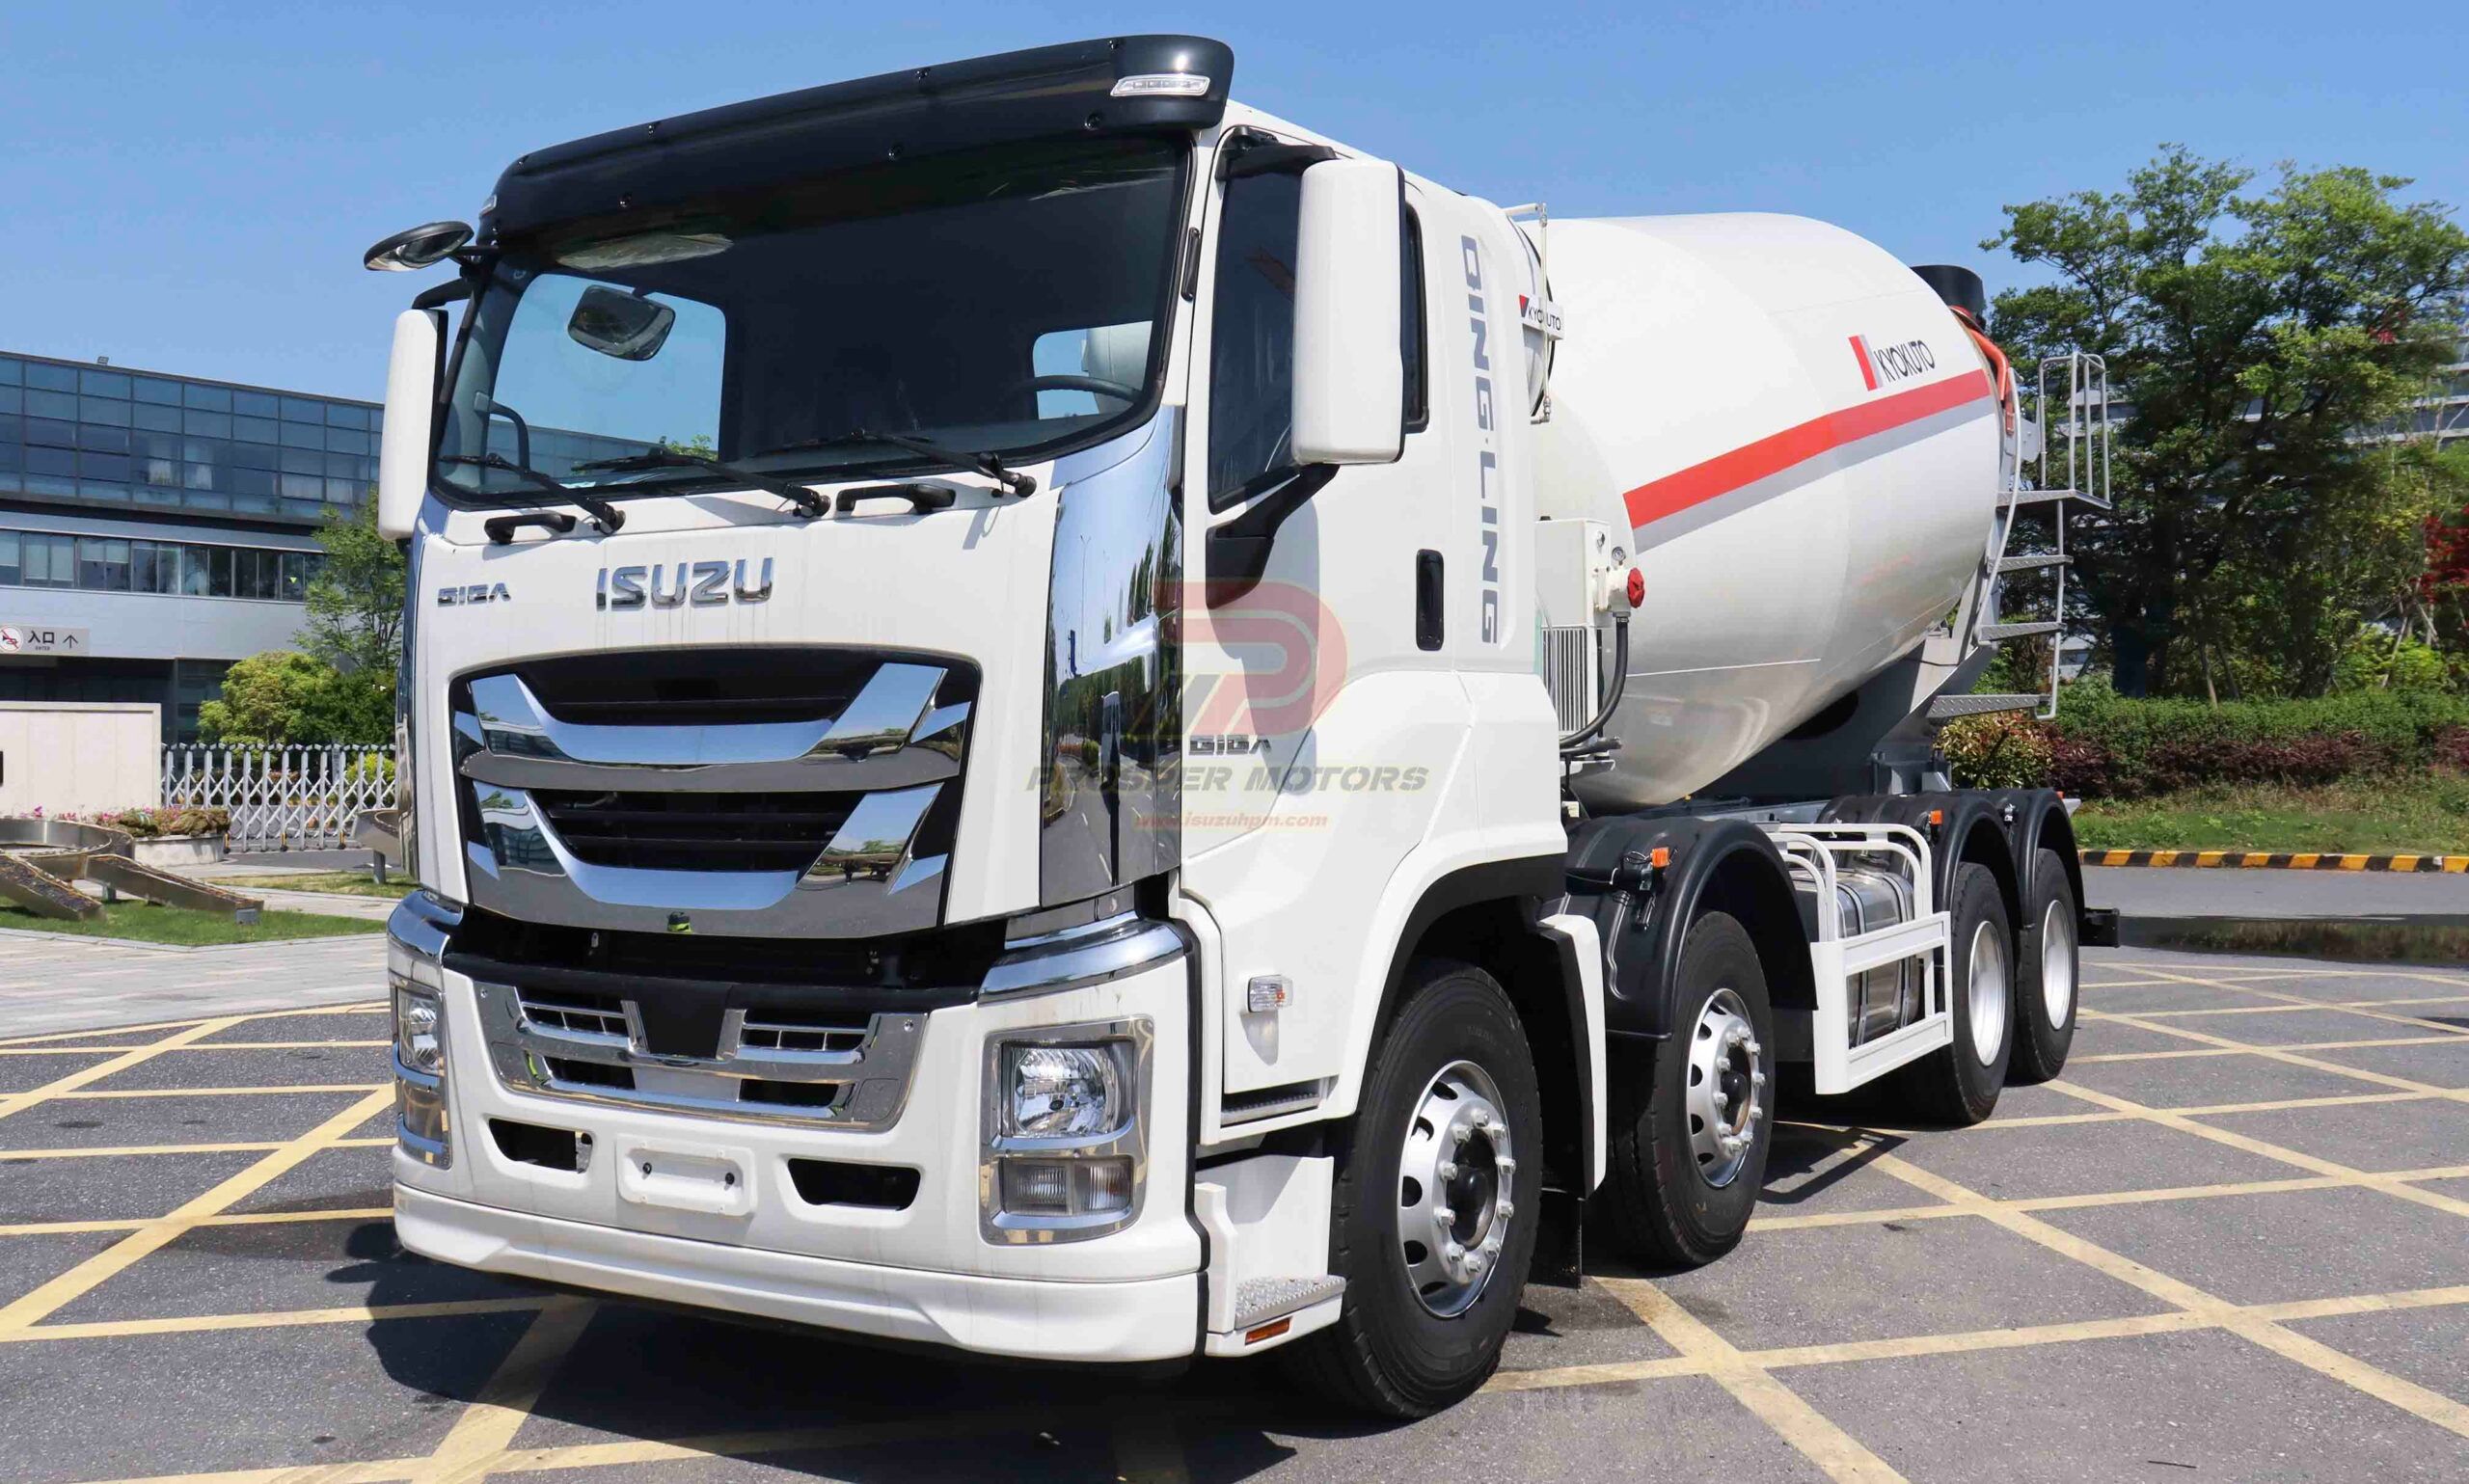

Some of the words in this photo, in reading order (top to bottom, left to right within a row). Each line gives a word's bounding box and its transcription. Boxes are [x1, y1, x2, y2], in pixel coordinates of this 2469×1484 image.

[1529, 306, 1560, 331] KYOUTO
[1873, 339, 1936, 382] KYOKUTO
[437, 582, 511, 607] GIGA
[596, 557, 774, 612] ISUZU
[28, 631, 55, 644] 入口
[1188, 735, 1272, 756] GIGA
